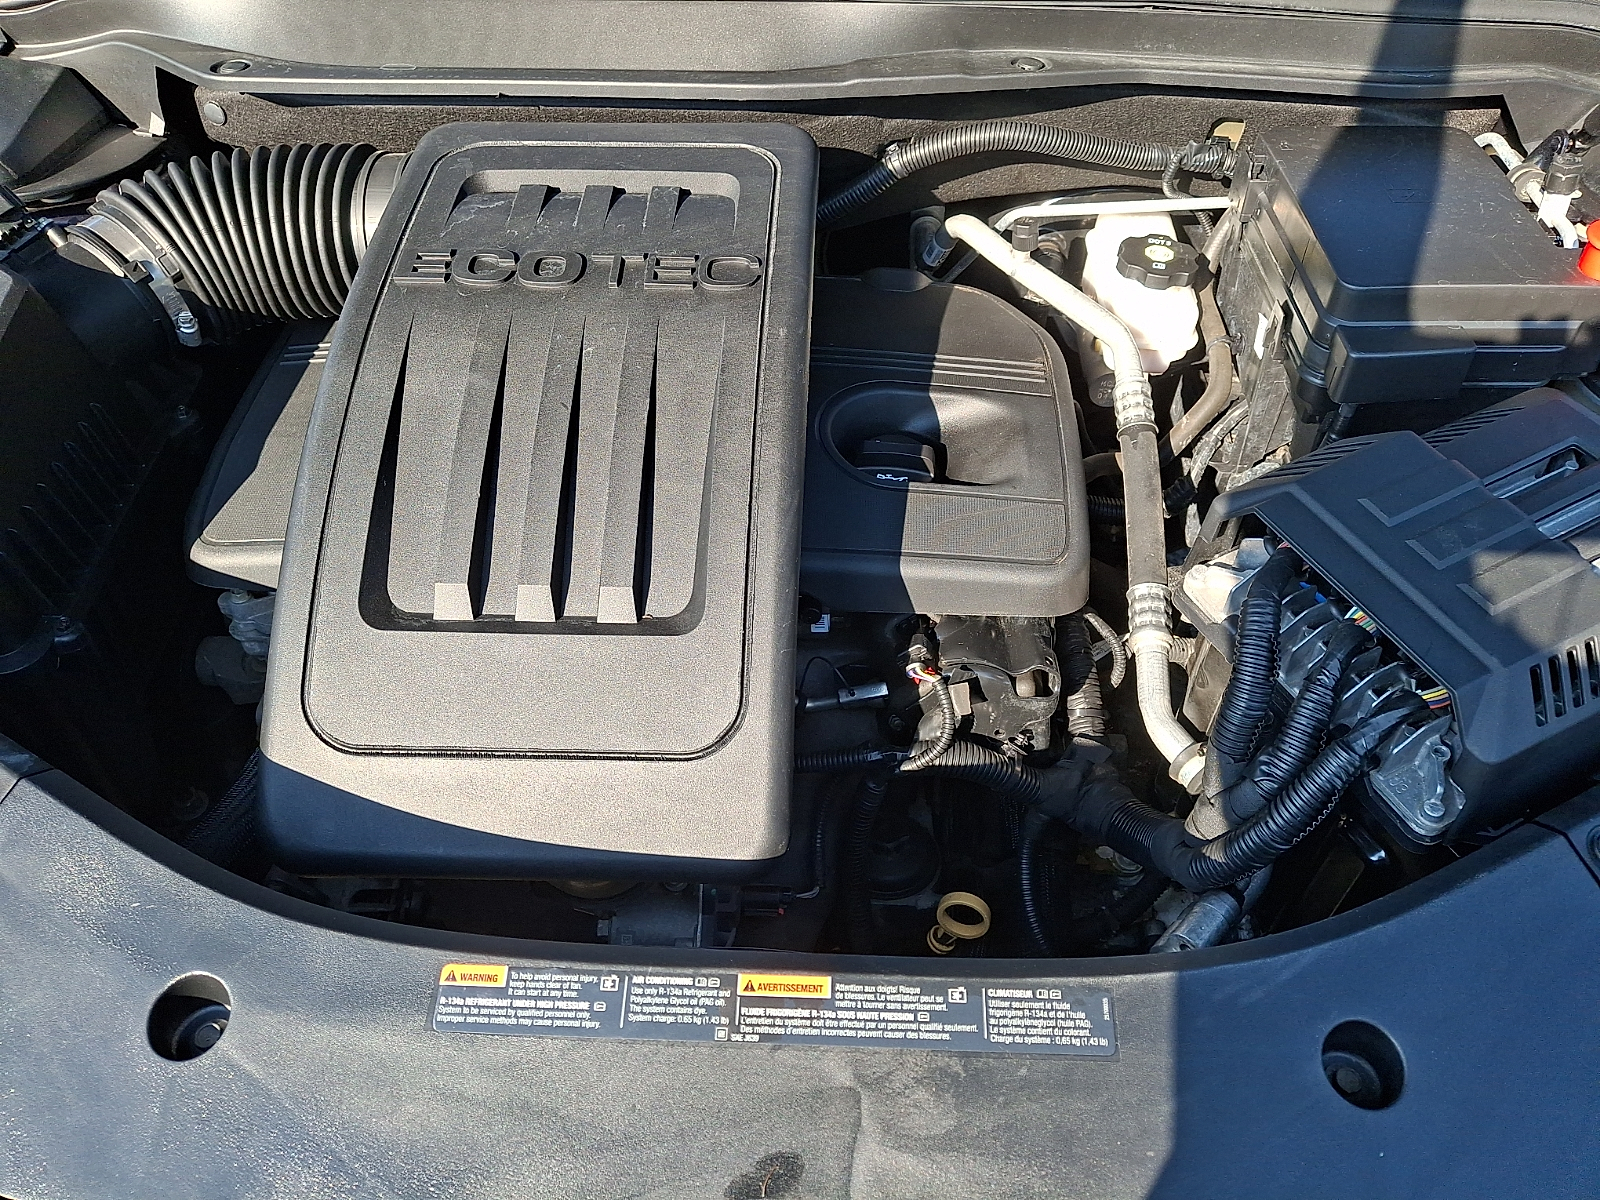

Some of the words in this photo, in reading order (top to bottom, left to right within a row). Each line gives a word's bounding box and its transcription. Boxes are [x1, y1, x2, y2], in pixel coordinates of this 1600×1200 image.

[393, 249, 762, 290] ECOTEC
[460, 972, 499, 983] WARNING
[511, 972, 519, 980] To
[519, 972, 533, 982] help
[552, 974, 579, 983] personal
[632, 976, 644, 984] AIR
[645, 977, 694, 986] CONDITIONING
[509, 980, 525, 988] keep
[562, 982, 570, 990] of
[758, 983, 824, 993] AVERTISSEMENT
[835, 983, 863, 992] Attention
[899, 985, 921, 994] Risque
[526, 989, 542, 997] start
[550, 991, 562, 999] any
[631, 987, 643, 995] Use
[644, 988, 657, 996] only
[659, 988, 682, 996] R-134a
[683, 989, 717, 998] Refrigerant
[718, 989, 731, 998] and
[844, 992, 876, 1001] blessures.
[887, 994, 919, 1002] ventilateur
[920, 995, 934, 1003] peut
[988, 988, 1033, 999] CLIMATISEUR
[440, 997, 464, 1005] R-134a
[465, 998, 511, 1008] REFRIGERANT
[513, 1000, 535, 1008] UNDER
[537, 1001, 553, 1009] HIGH
[555, 1001, 590, 1010] PRESSURE
[630, 996, 669, 1005] Polyalkylene
[670, 997, 689, 1006] Glycol
[699, 998, 714, 1007] (PAG
[835, 1000, 856, 1008] mettre
[863, 1001, 884, 1009] tourner
[886, 1002, 901, 1010] sans
[902, 1003, 948, 1011] avertissement.
[989, 1000, 1010, 1008] Utiliser
[1011, 1000, 1045, 1009] seulement
[1046, 1001, 1052, 1010] le
[1053, 1002, 1071, 1010] fluide
[438, 1006, 462, 1015] System
[480, 1008, 506, 1016] serviced
[507, 1009, 516, 1017] by
[517, 1009, 543, 1019] qualified
[544, 1010, 576, 1019] personnel
[576, 1011, 591, 1019] only.
[630, 1004, 642, 1012] The
[642, 1006, 665, 1014] system
[666, 1006, 693, 1014] contains
[694, 1007, 708, 1016] dye.
[741, 1007, 766, 1016] FLUIDE
[811, 1010, 836, 1018] R-134a
[837, 1010, 856, 1019] SOUS
[857, 1012, 879, 1020] HAUTE
[880, 1012, 914, 1021] PRESSION
[1024, 1010, 1048, 1018] R-134a
[1049, 1010, 1056, 1018] et
[1056, 1010, 1066, 1018] de
[437, 1015, 465, 1024] Improper
[490, 1017, 517, 1025] methods
[518, 1019, 533, 1027] may
[553, 1019, 580, 1028] personal
[582, 1020, 601, 1030] injury.
[628, 1014, 651, 1023] System
[653, 1015, 676, 1024] charge:
[693, 1016, 702, 1025] kg
[703, 1016, 720, 1025] (1.43
[775, 1018, 783, 1026] du
[866, 1021, 876, 1030] par
[887, 1022, 919, 1031] personnel
[944, 1024, 978, 1032] seulement.
[1057, 1019, 1074, 1028] (huile
[740, 1025, 753, 1033] Des
[754, 1026, 785, 1035] méthodes
[822, 1028, 856, 1036] incorrectes
[857, 1030, 883, 1039] peuvent
[884, 1031, 905, 1039] causer
[906, 1031, 918, 1039] des
[919, 1032, 951, 1040] blessures.
[990, 1026, 998, 1034] Le
[1027, 1027, 1053, 1035] contient
[1054, 1027, 1062, 1035] du
[1063, 1028, 1092, 1037] colorant.
[990, 1035, 1013, 1044] Charge
[1056, 1037, 1071, 1045] 0,65
[1072, 1037, 1080, 1047] kg
